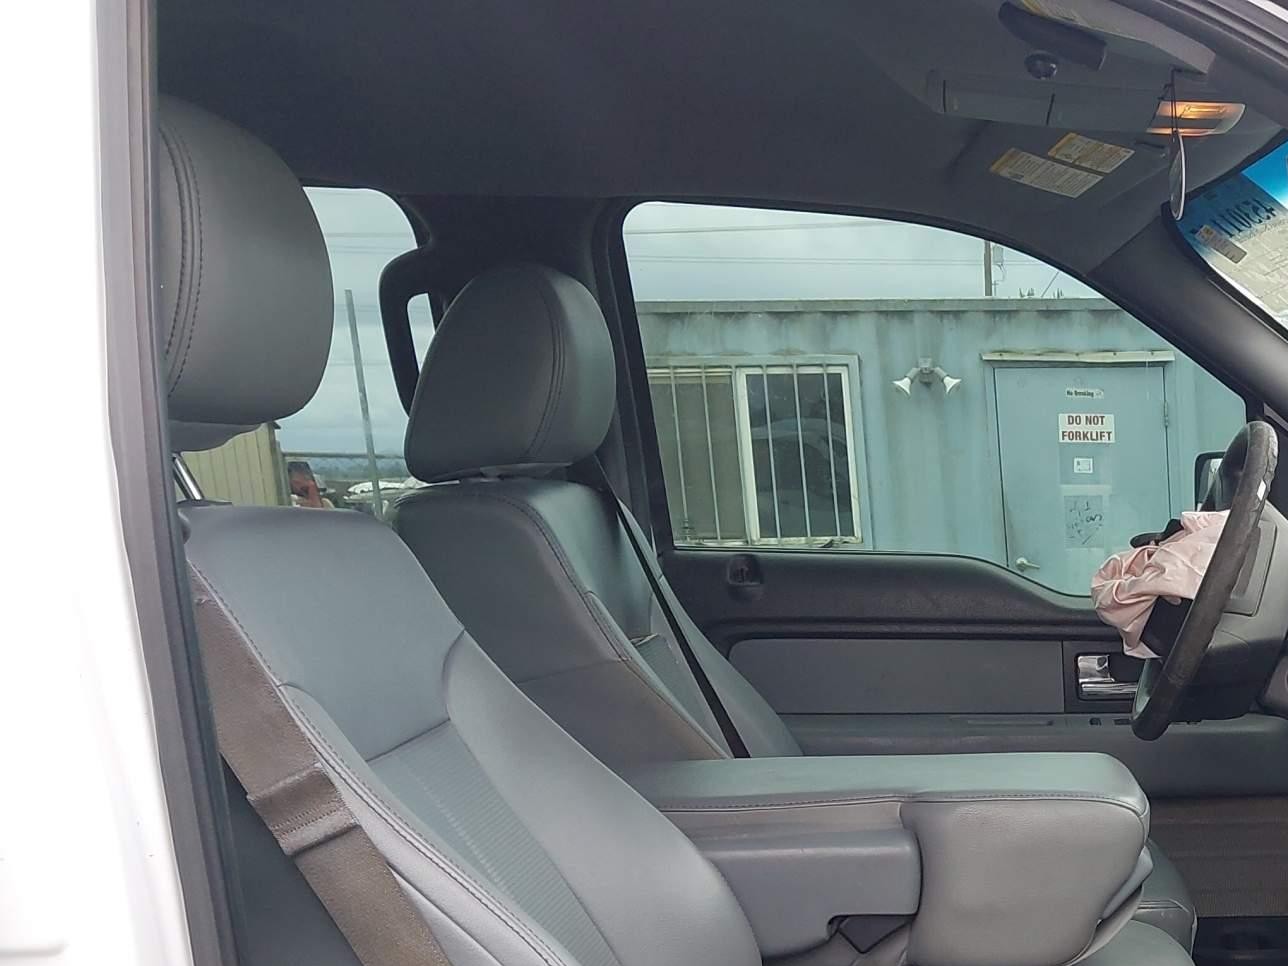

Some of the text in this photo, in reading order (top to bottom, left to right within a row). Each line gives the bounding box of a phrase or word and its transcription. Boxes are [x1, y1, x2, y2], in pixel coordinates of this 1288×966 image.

[1067, 415, 1106, 426] DO NOT
[1061, 430, 1113, 442] FORKLIFT
